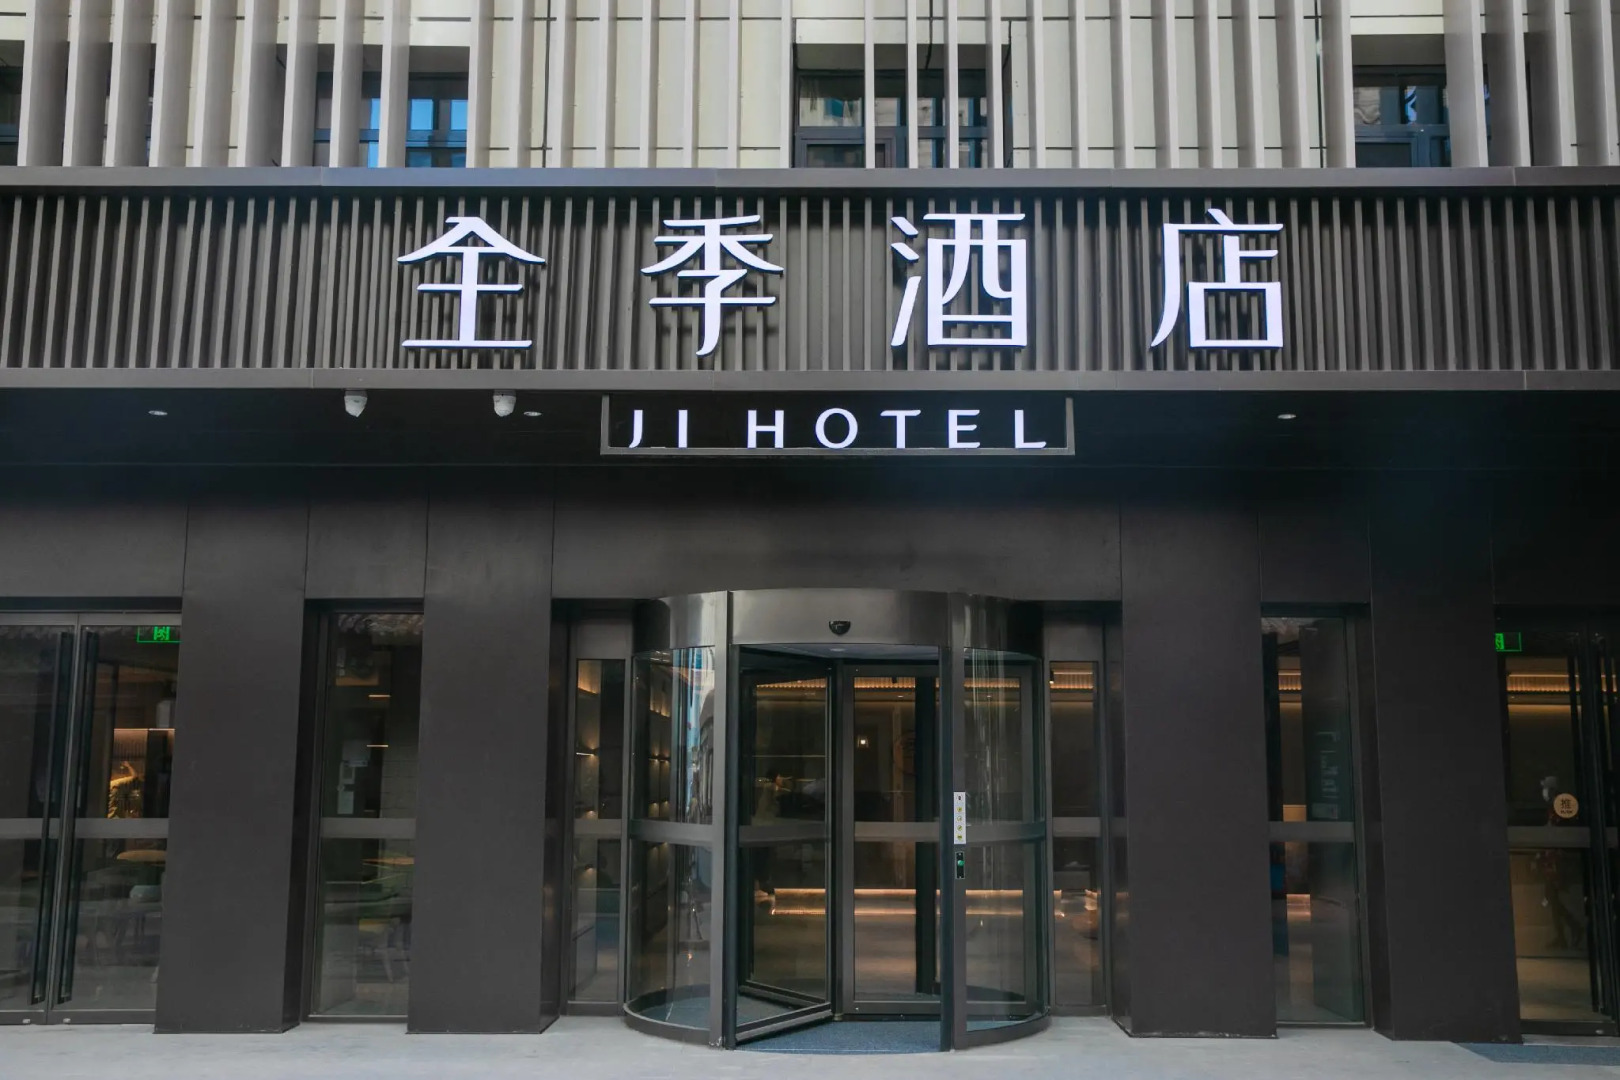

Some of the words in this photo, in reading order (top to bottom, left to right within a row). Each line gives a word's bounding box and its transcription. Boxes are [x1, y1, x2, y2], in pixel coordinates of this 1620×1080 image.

[397, 208, 1285, 357] 全季酒店
[629, 409, 688, 448] JI
[747, 408, 1047, 449] HOTEL
